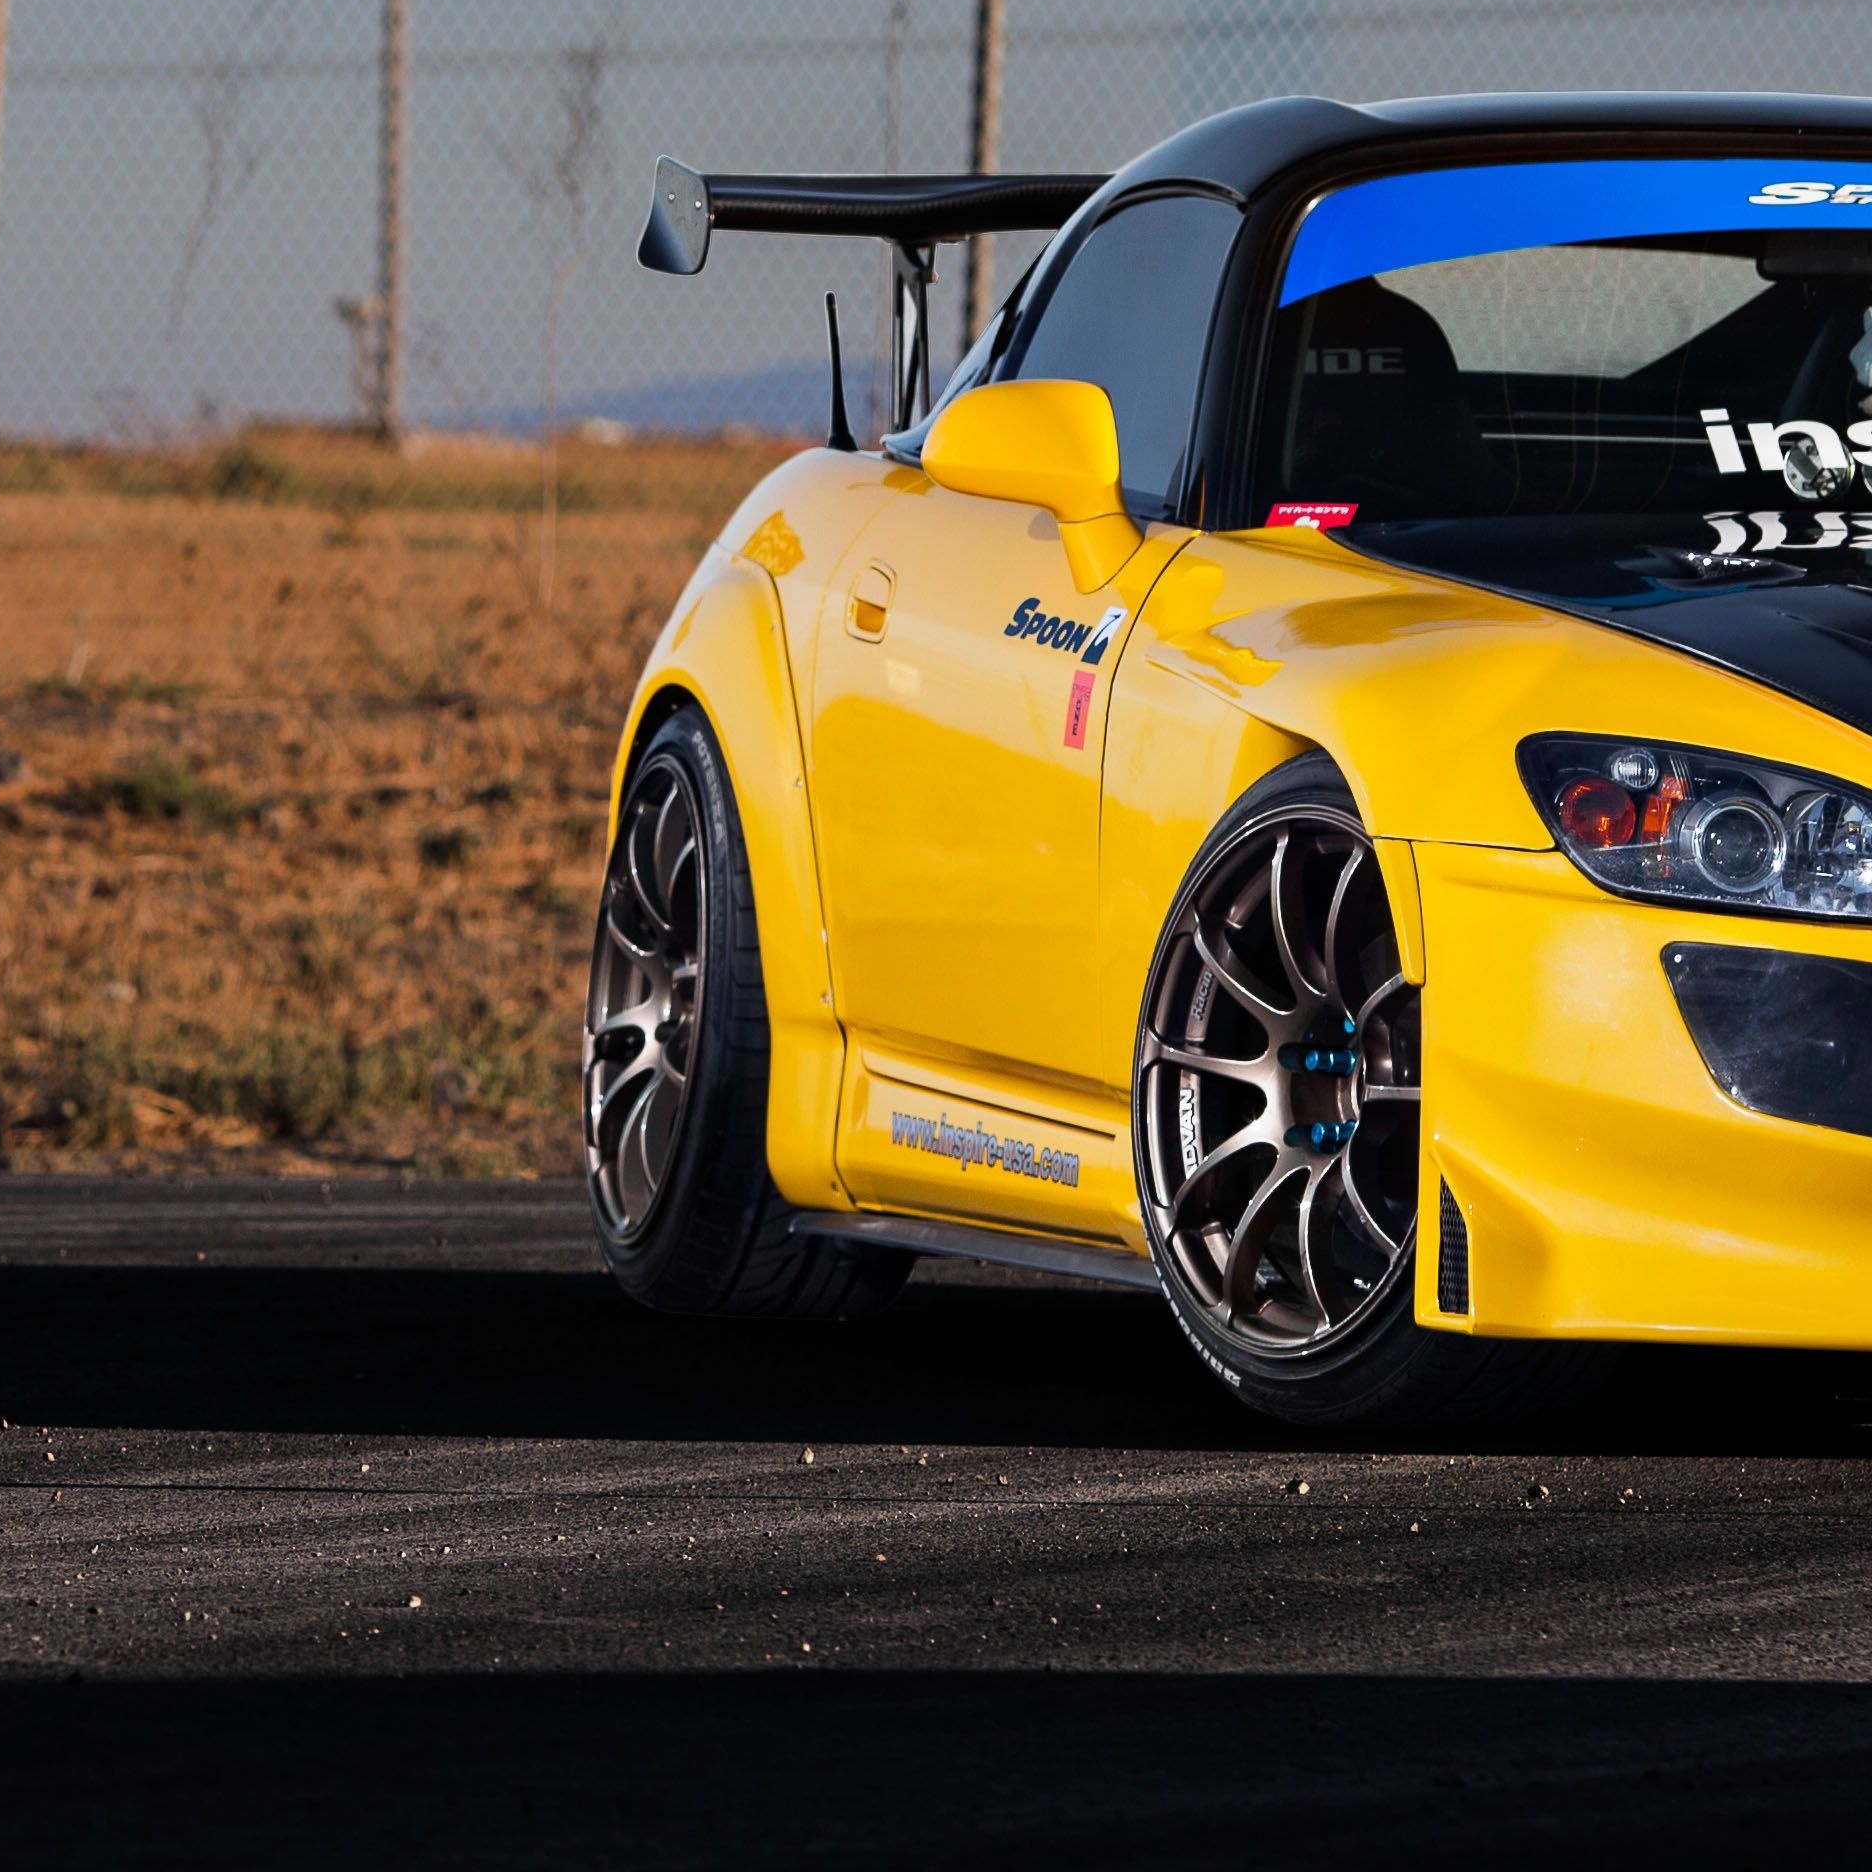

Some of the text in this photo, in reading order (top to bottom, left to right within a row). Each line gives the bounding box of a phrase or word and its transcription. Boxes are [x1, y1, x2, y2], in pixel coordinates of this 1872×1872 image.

[1004, 597, 1093, 654] SPOON
[1192, 970, 1213, 1021] Racin
[891, 1111, 1080, 1188] www.inspire-usa.com
